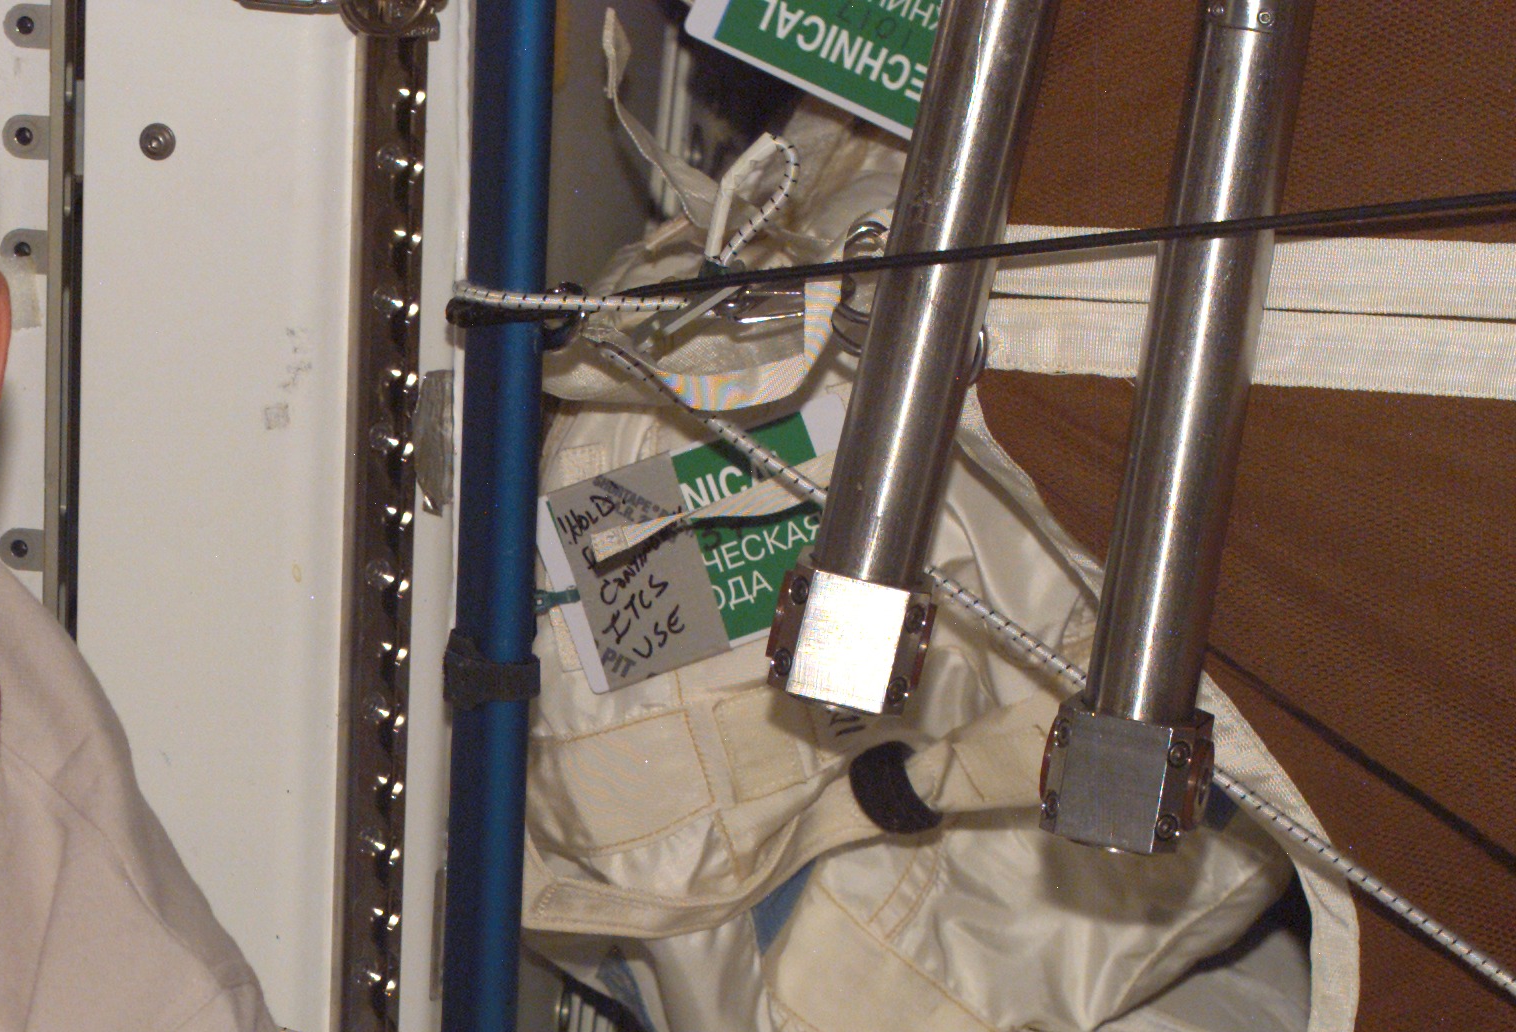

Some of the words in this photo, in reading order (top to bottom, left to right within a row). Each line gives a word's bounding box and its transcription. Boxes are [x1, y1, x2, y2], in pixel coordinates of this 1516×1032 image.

[758, 0, 928, 102] ECHNICAL
[601, 573, 669, 645] ITCS
[632, 604, 685, 659] USE
